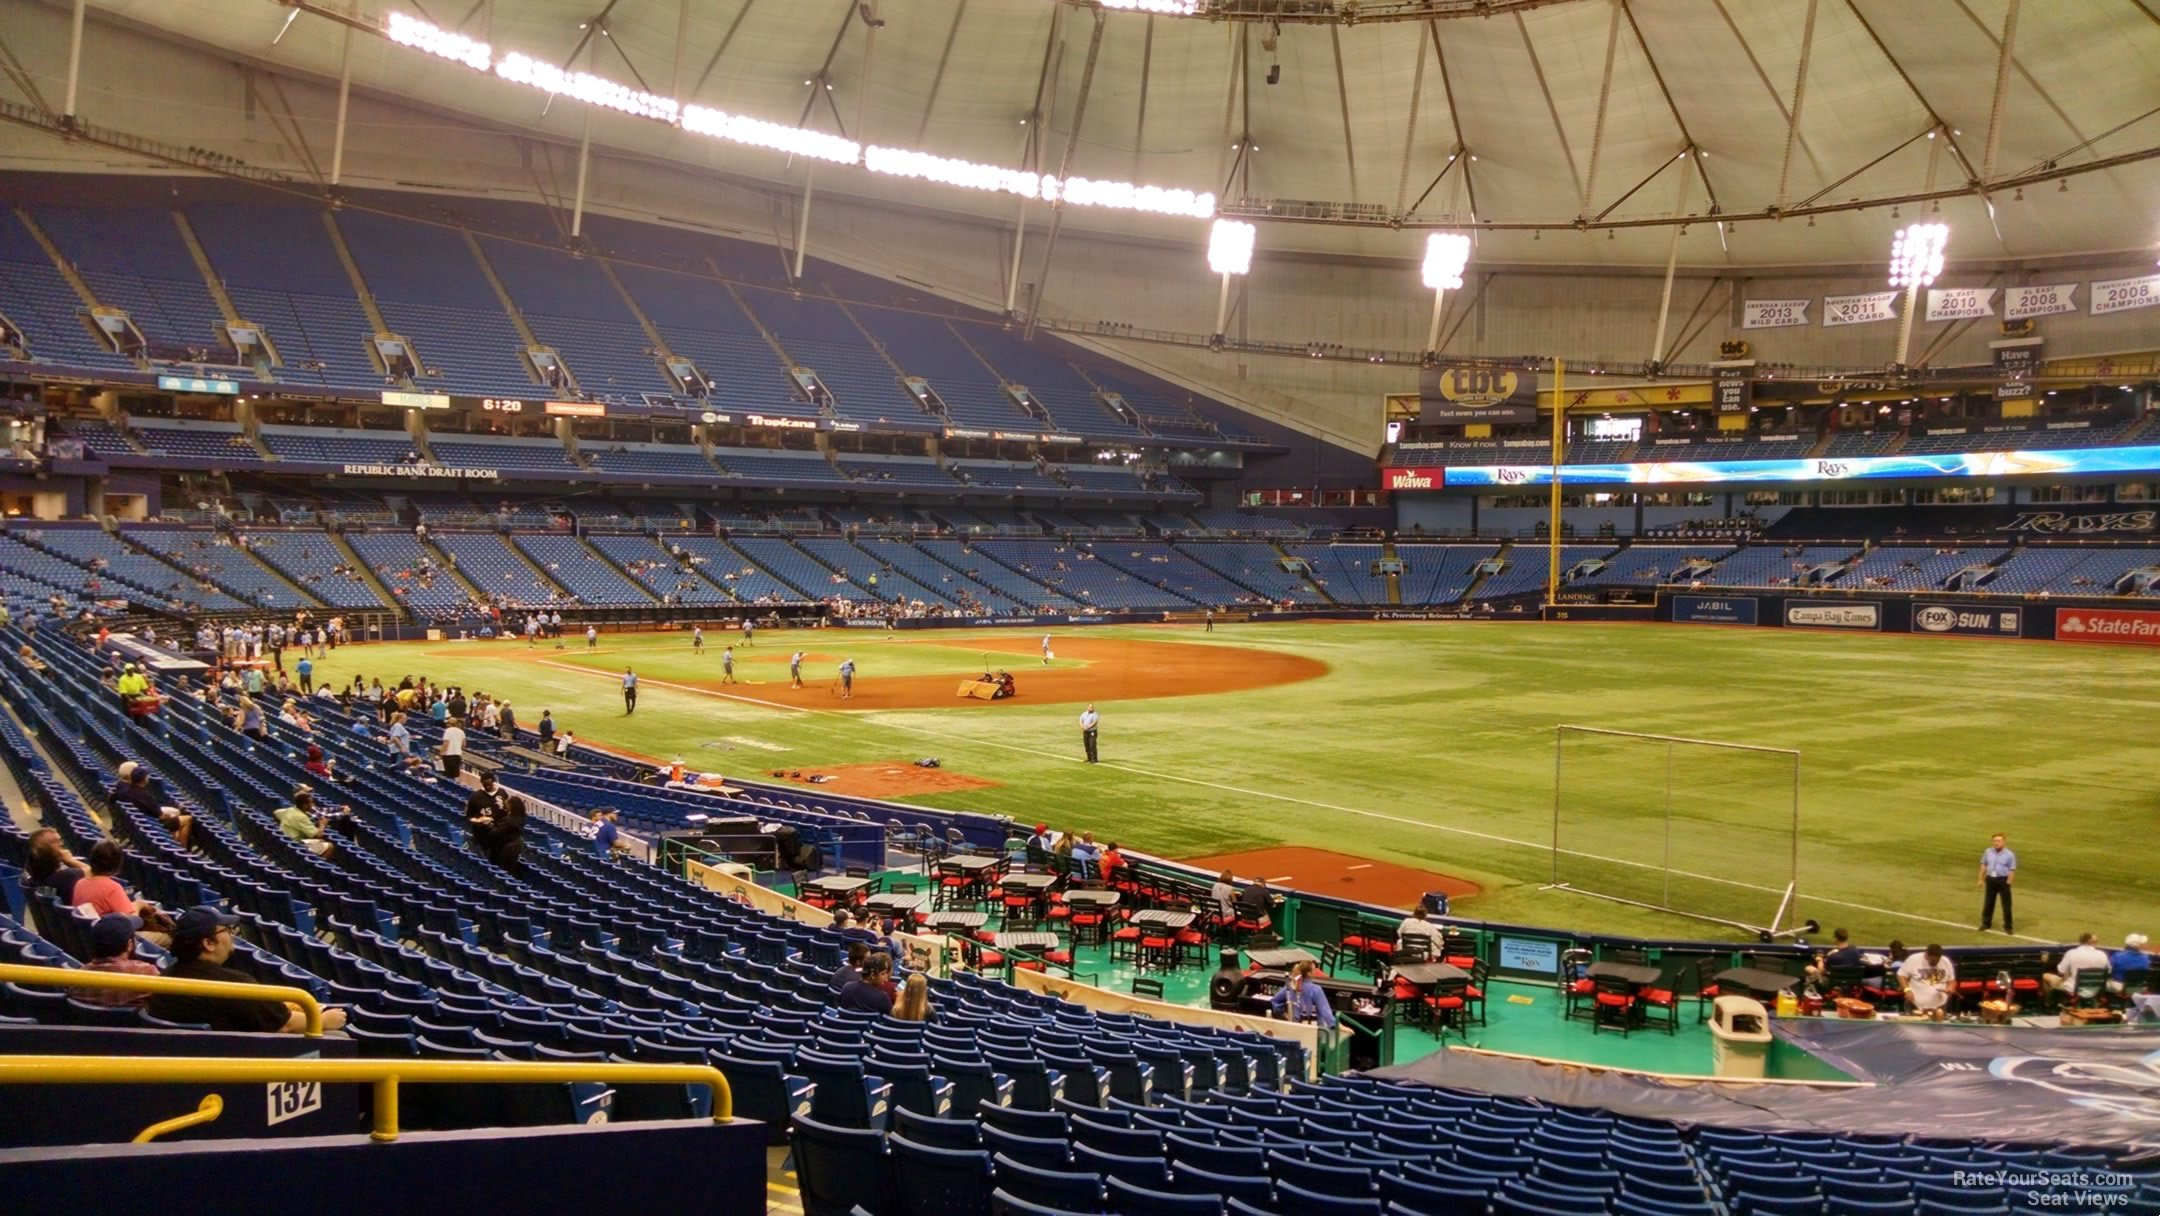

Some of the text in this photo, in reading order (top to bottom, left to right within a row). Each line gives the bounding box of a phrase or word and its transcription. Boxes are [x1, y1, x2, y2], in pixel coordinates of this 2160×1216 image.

[2023, 286, 2055, 296] AL EAST
[2108, 285, 2148, 301] 2008
[1942, 298, 1976, 309] 2010
[2020, 293, 2057, 308] 2008
[2096, 296, 2159, 310] CHAMPIONS
[1760, 308, 1792, 318] 2013
[1842, 303, 1876, 315] 2011
[1931, 307, 1985, 317] CHAMPIONS
[2009, 304, 2067, 316] CHAMPIONS
[1831, 312, 1885, 323] WILD CARD
[1720, 342, 1745, 354] tbt
[2002, 350, 2030, 360] Have
[1451, 368, 1507, 394] tbt
[1722, 387, 1740, 397] you
[1998, 386, 2031, 397] buzz?
[482, 399, 522, 412] 6:20
[746, 415, 816, 428] Tropicana
[1400, 442, 1444, 450] tampabay.com
[1504, 440, 1550, 448] tampabay.com
[344, 464, 498, 478] REPUBLIC BANK DRAFT ROOM
[1392, 475, 1432, 488] Wawa
[1696, 602, 1732, 610] JABIL
[1392, 612, 1427, 620] Petersburg
[1792, 610, 1873, 623] Tampa Bay Times
[1926, 612, 1948, 622] FOX
[1958, 612, 1991, 628] SUN
[2130, 620, 2160, 636] Far
[1938, 1062, 1983, 1072] TM
[270, 1082, 317, 1118] 132
